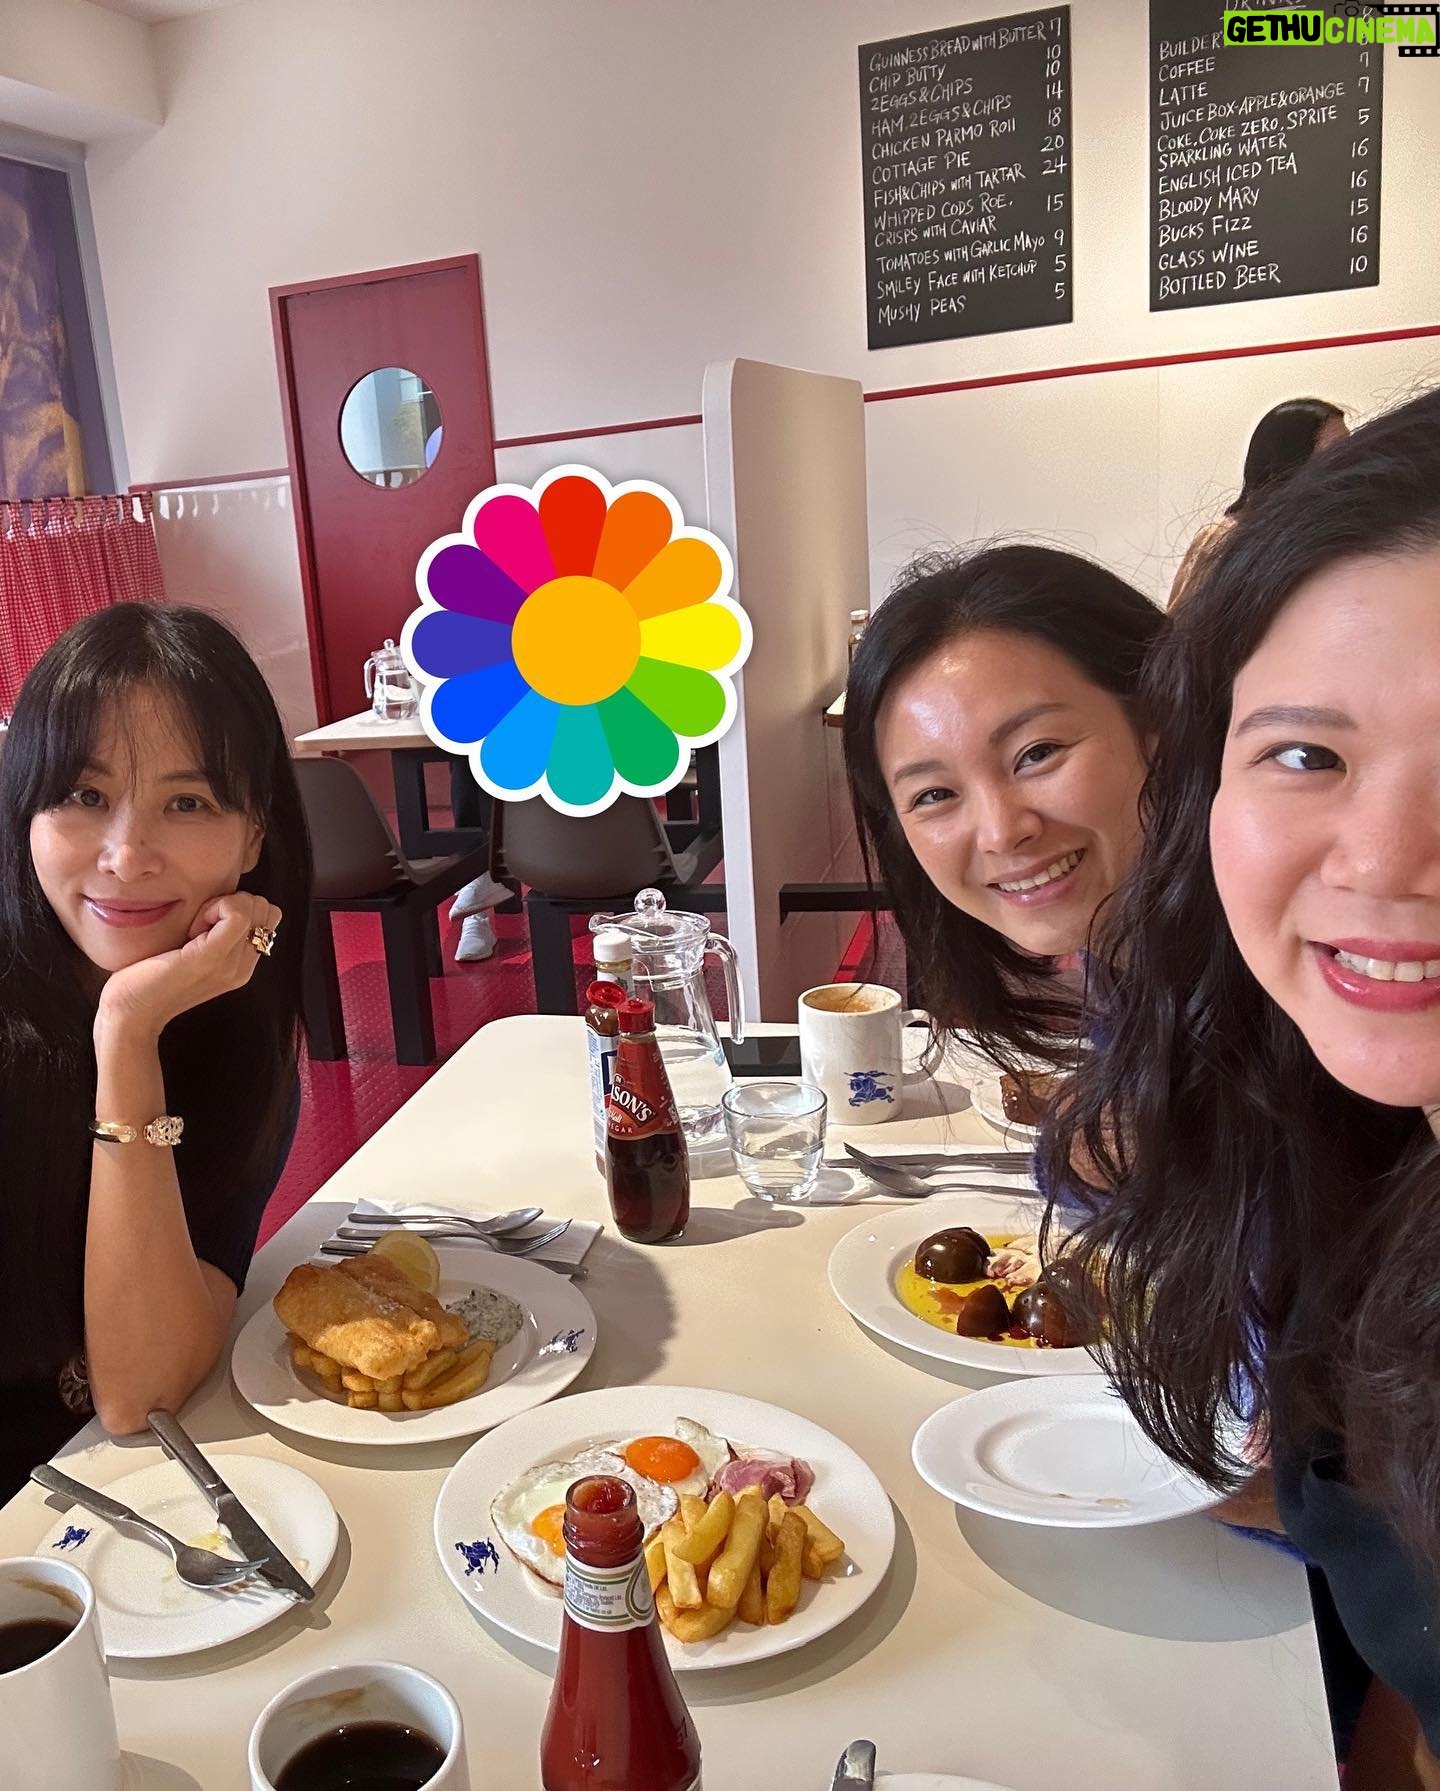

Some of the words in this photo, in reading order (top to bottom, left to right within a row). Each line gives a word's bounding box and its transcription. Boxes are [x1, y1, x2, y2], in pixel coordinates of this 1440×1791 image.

[869, 47, 928, 72] GUINNESS
[930, 36, 971, 60] BREAD
[999, 21, 1046, 49] BUTTER
[1050, 17, 1061, 37] 7
[869, 74, 901, 93] CHIP
[905, 64, 946, 86] BUTTY
[1047, 44, 1061, 60] 10
[1046, 60, 1060, 77] 10
[1047, 80, 1063, 100] 14
[1159, 56, 1216, 81] COFFEE
[1160, 81, 1208, 106] LATTE
[1160, 108, 1205, 132] JUICE
[1358, 76, 1369, 94] 7
[872, 132, 930, 160] CHICKEN
[935, 124, 983, 148] PARMO
[1048, 107, 1062, 127] 18
[1199, 124, 1236, 145] COKE
[1287, 105, 1338, 130] SPRITE
[1358, 108, 1370, 125] 5
[872, 155, 937, 185] COTTAGE
[944, 151, 971, 170] PIE
[1040, 135, 1065, 152] 20
[975, 163, 1026, 190] TARTAR
[1042, 155, 1067, 175] 24
[1158, 142, 1233, 172] SPARKLING
[1238, 132, 1288, 157] WATER
[1159, 164, 1221, 195] ENGLISH
[1227, 161, 1261, 183] ICED
[1266, 152, 1297, 175] TEA
[1351, 138, 1369, 158] 16
[874, 204, 936, 231] WHIPPED
[941, 199, 974, 216] CODS
[1047, 193, 1064, 212] 15
[1159, 196, 1212, 222] BLOODY
[1218, 185, 1260, 211] MARY
[1351, 169, 1368, 189] 16
[874, 227, 918, 248] CRISPS
[922, 223, 946, 239] WITH
[950, 215, 998, 235] CAVIAR
[1159, 223, 1204, 247] BUCKS
[1212, 215, 1252, 236] FIZZ
[1351, 198, 1369, 216] 15
[876, 249, 940, 274] TOMATOES
[944, 245, 969, 263] WITH
[970, 238, 1011, 258] GARLIC
[1054, 228, 1065, 246] 9
[1159, 250, 1205, 271] GLASS
[1212, 240, 1259, 264] WINE
[1351, 225, 1368, 243] 16
[877, 276, 921, 300] SMILEY
[928, 270, 958, 291] FACE
[963, 266, 985, 284] WITH
[989, 259, 1037, 282] KETCHUP
[1054, 254, 1067, 272] 5
[1160, 271, 1226, 300] BOTTLED
[1233, 263, 1281, 289] BEER
[1350, 255, 1368, 274] 10
[878, 303, 921, 326] MUSHY
[930, 295, 967, 316] PEAS
[1054, 282, 1065, 300] 5
